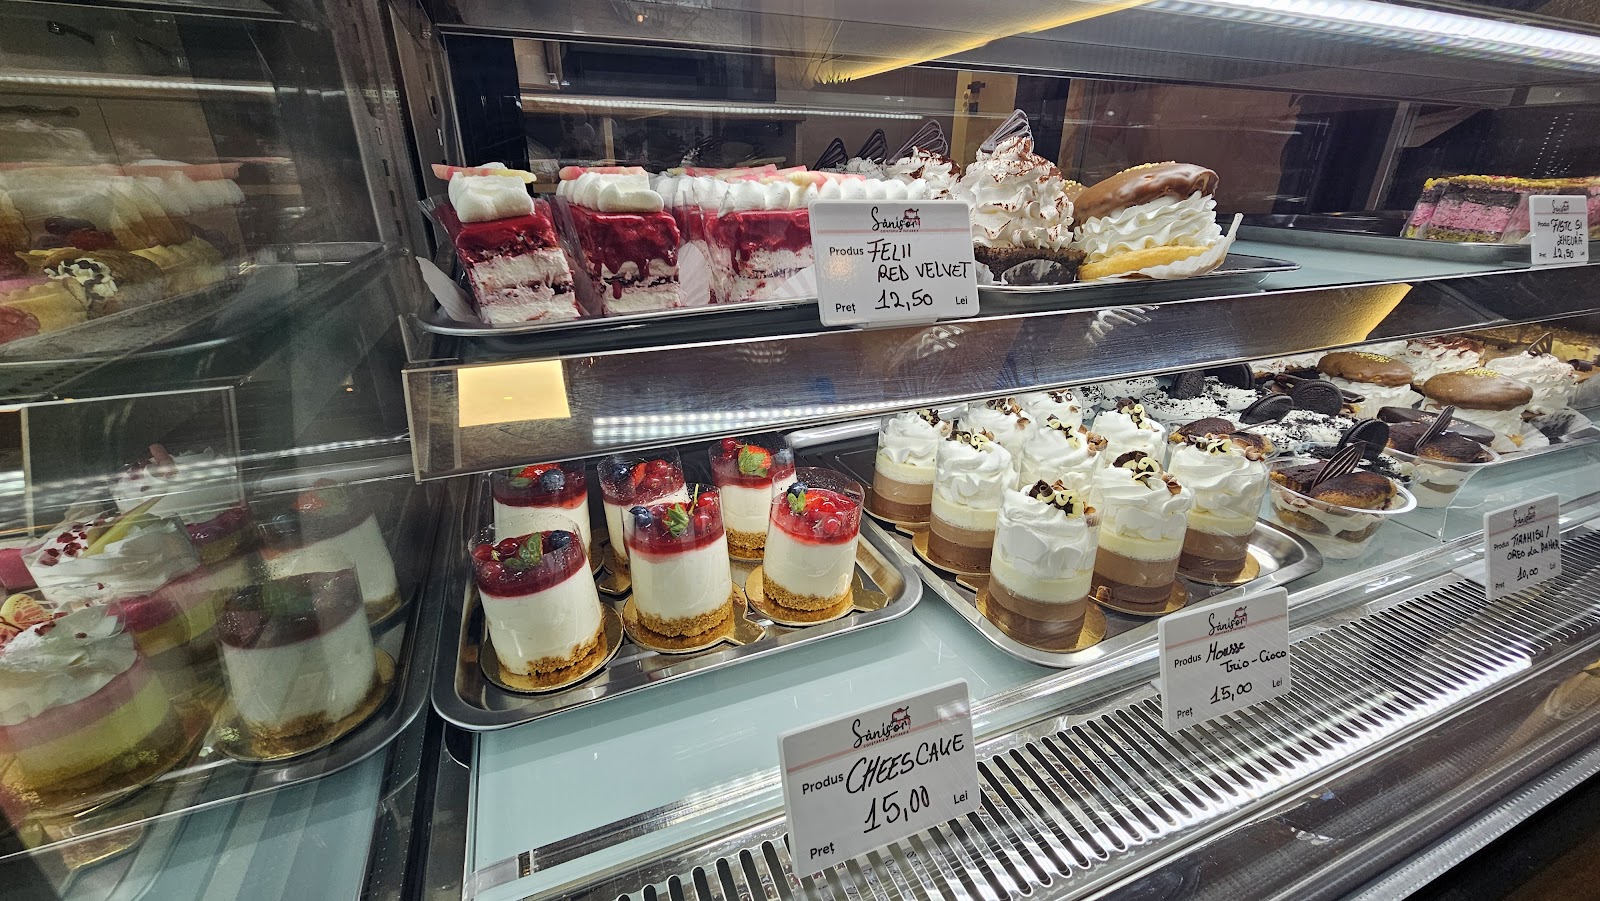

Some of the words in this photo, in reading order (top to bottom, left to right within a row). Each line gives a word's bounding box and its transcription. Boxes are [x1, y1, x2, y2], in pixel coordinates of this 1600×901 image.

[829, 247, 864, 256] Produs
[866, 238, 911, 262] FELII
[1552, 246, 1574, 259] 12,50
[877, 264, 909, 282] RED
[915, 261, 972, 278] VELVET
[835, 303, 856, 313] Preț
[874, 289, 933, 311] 12,50
[955, 296, 968, 305] Lei
[1516, 567, 1538, 581] 10,00
[1174, 654, 1202, 668] Produs
[1177, 706, 1193, 719] Preț
[1210, 681, 1253, 705] 15,00
[1272, 677, 1283, 688] Lei
[802, 773, 844, 794] Produs
[810, 842, 835, 860] Preț
[863, 785, 930, 834] 15,00
[953, 790, 968, 804] Lei
